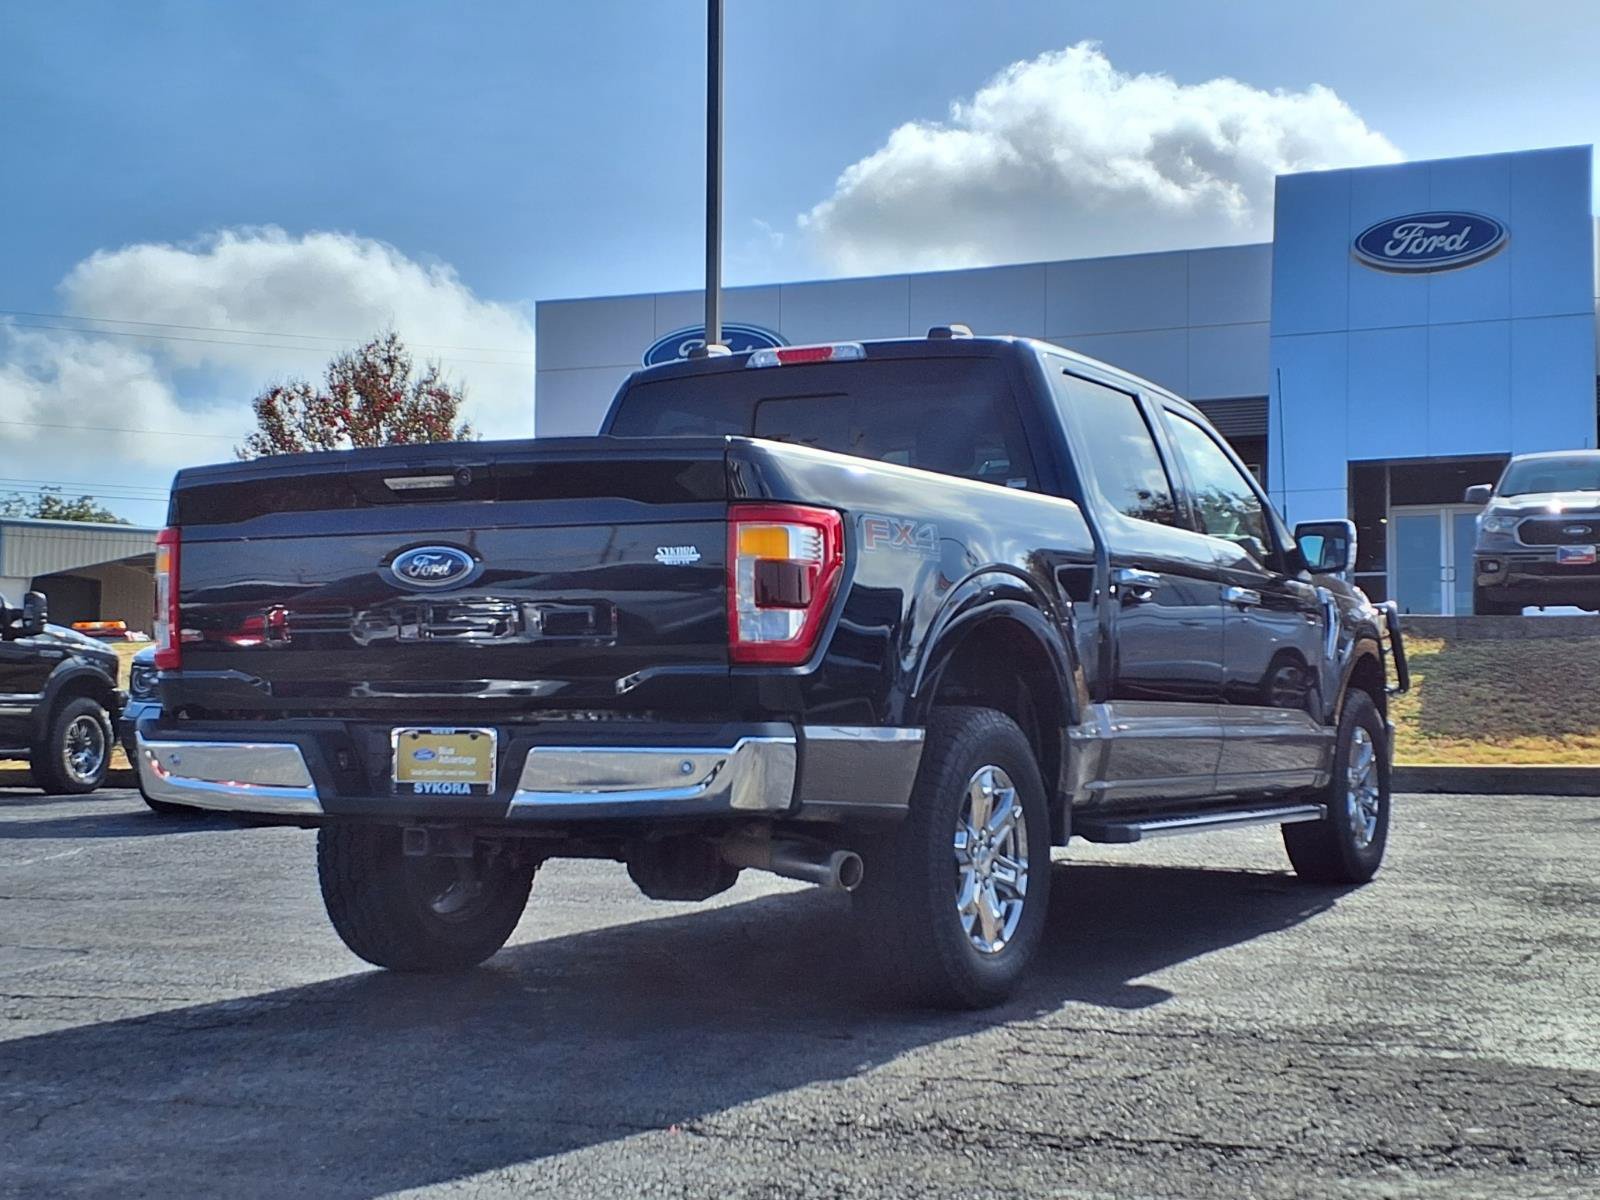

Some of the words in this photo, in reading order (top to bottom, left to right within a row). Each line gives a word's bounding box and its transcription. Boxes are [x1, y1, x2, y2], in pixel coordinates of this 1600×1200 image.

[1384, 220, 1472, 256] Ford
[862, 515, 940, 556] FX4
[409, 554, 453, 577] Ford
[413, 782, 472, 795] SYKORA
